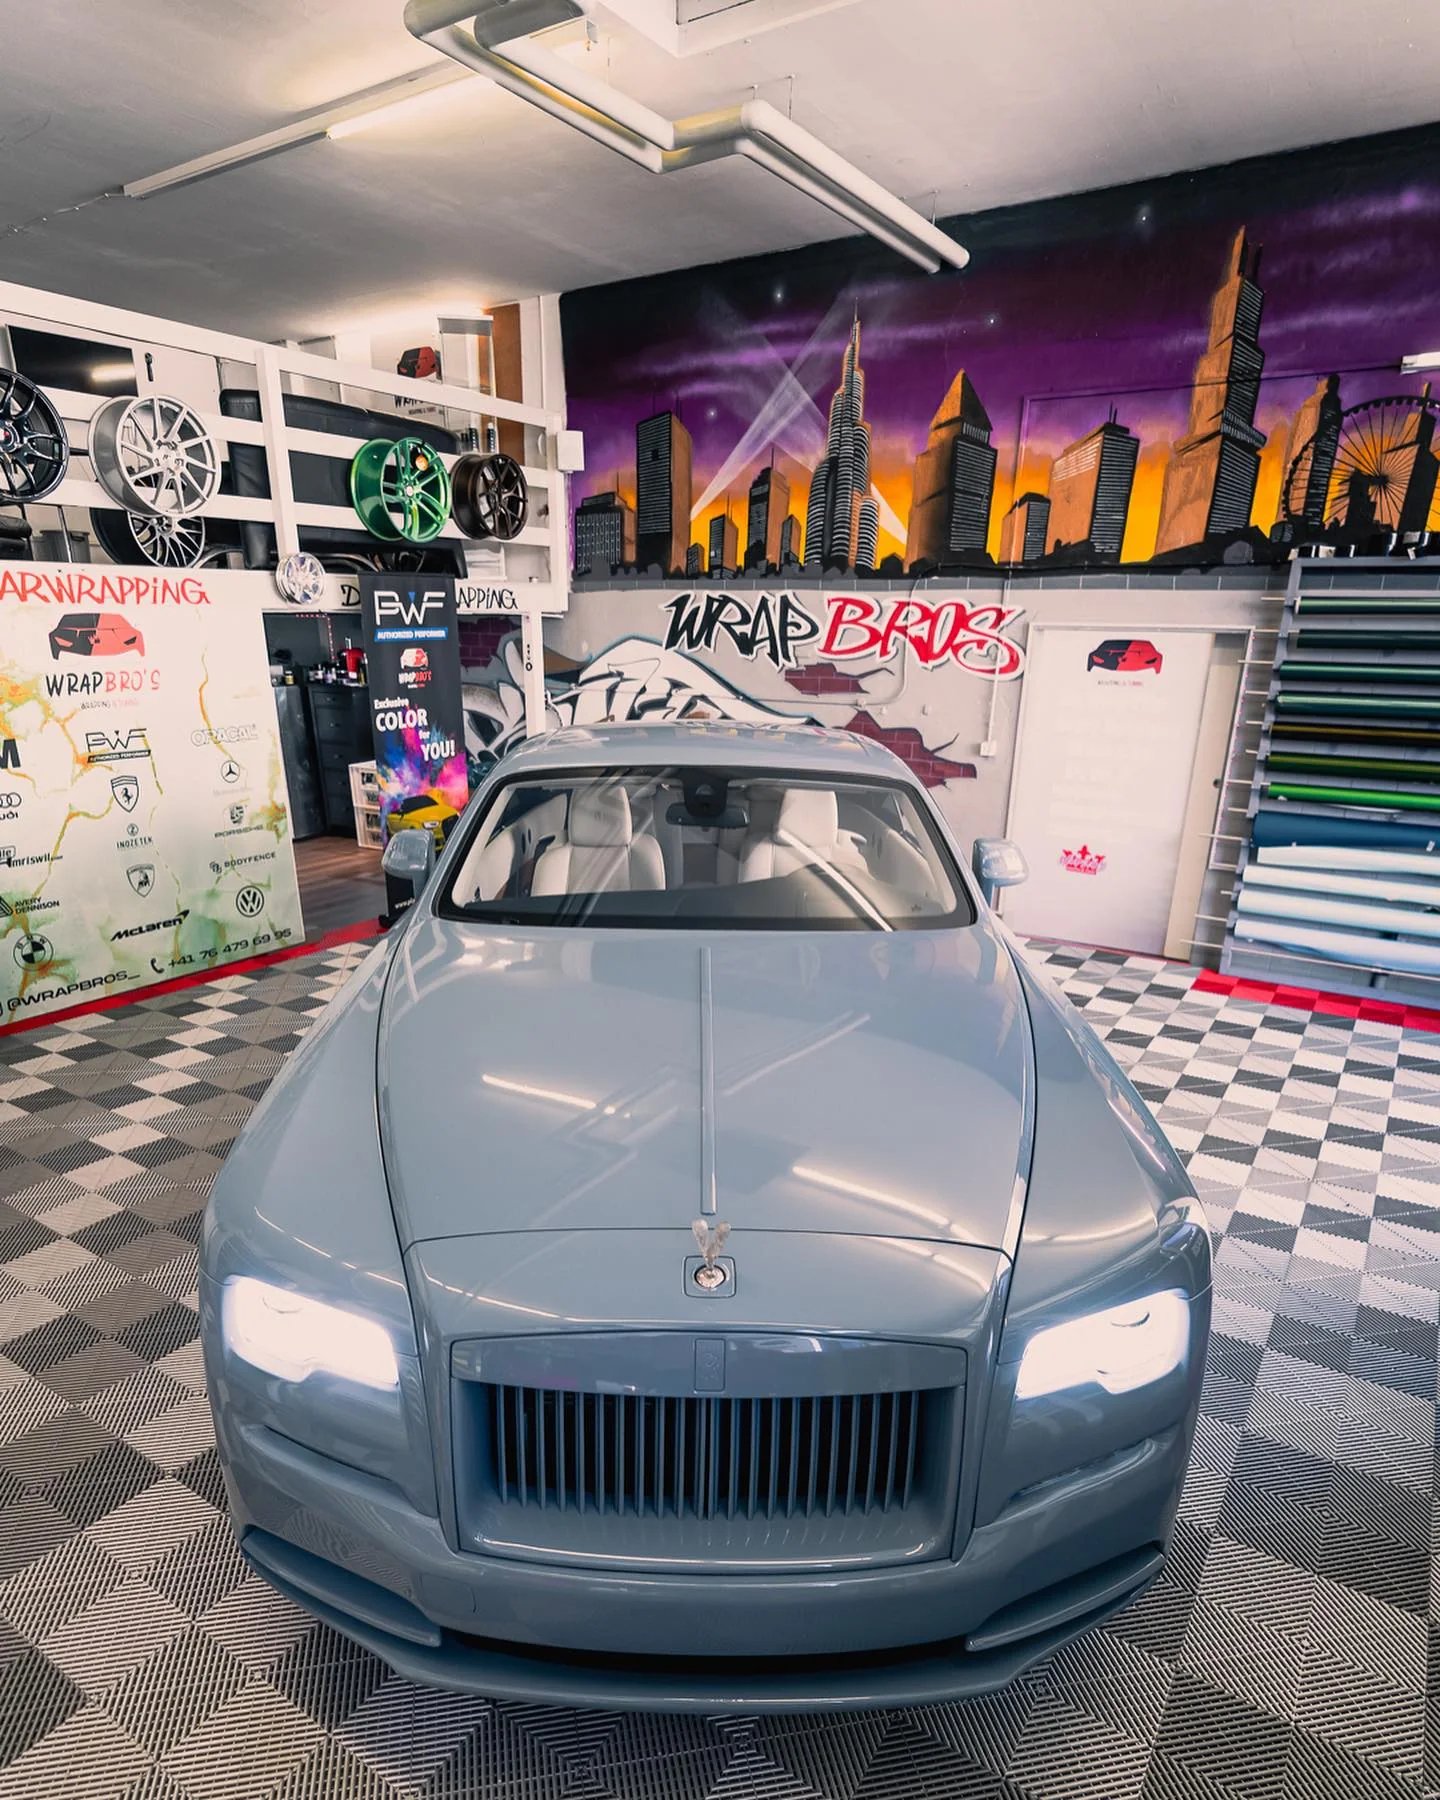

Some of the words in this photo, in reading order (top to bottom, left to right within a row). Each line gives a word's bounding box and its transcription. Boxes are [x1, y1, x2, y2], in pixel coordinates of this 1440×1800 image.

[661, 589, 821, 671] WRAP
[816, 591, 1026, 681] BROS
[374, 696, 409, 710] Exclusive
[375, 708, 428, 732] COLOR
[418, 730, 431, 740] for
[420, 740, 456, 762] YOU!
[224, 851, 276, 868] BODYFENCE
[15, 897, 42, 907] AVERY
[15, 900, 60, 914] DENNISON
[110, 917, 184, 942] McLaren
[199, 948, 218, 961] 76
[223, 939, 249, 954] 479
[253, 934, 271, 946] 69
[274, 928, 292, 941] 95
